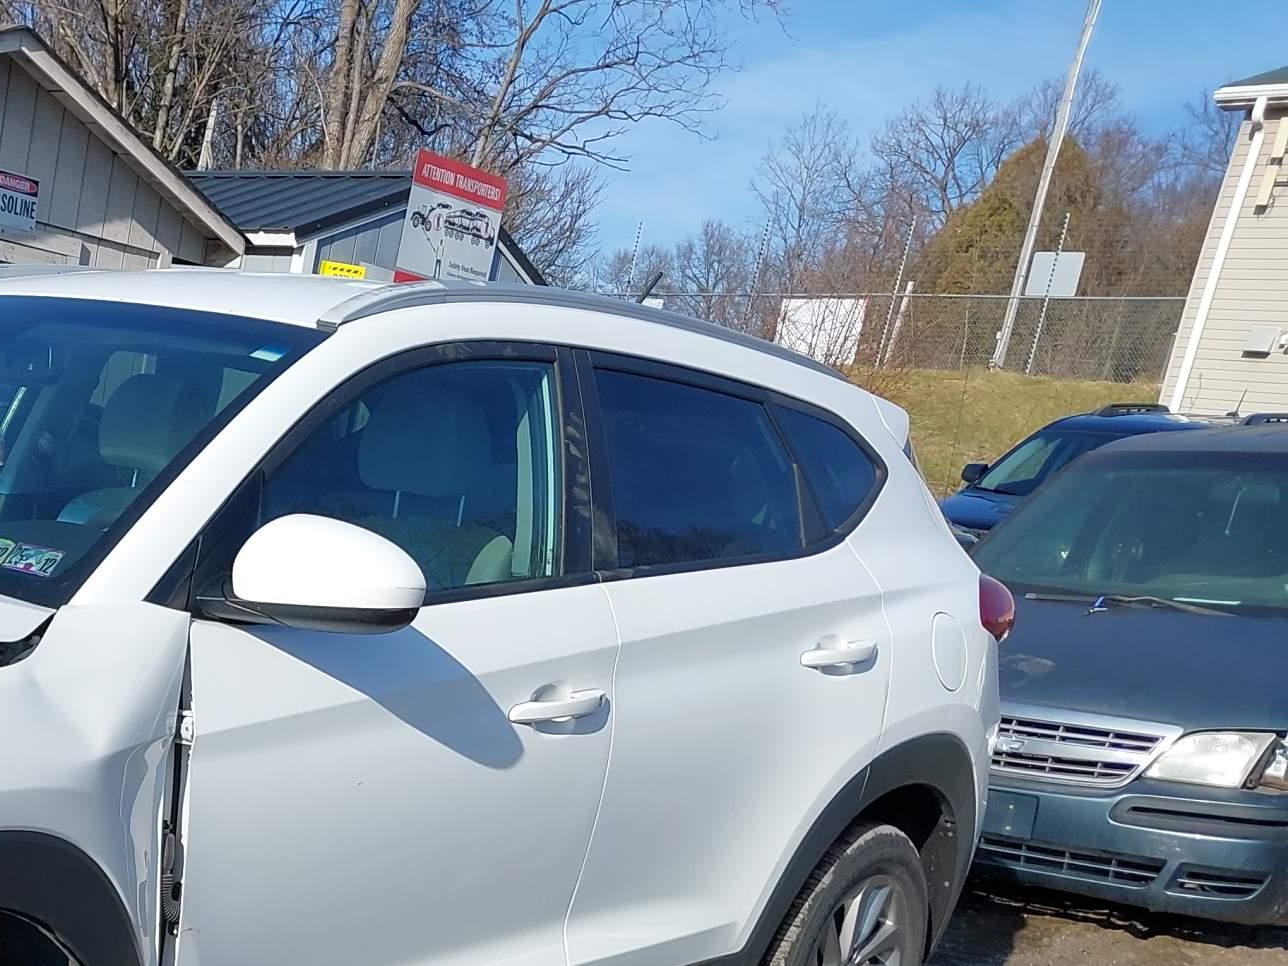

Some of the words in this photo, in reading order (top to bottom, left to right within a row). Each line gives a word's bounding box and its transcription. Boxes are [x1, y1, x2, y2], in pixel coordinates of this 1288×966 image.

[0, 175, 31, 192] DANGER
[421, 163, 456, 187] ATTENTION
[455, 174, 502, 202] TRANSPORTERS!
[8, 547, 30, 565] 25
[38, 557, 57, 573] 12
